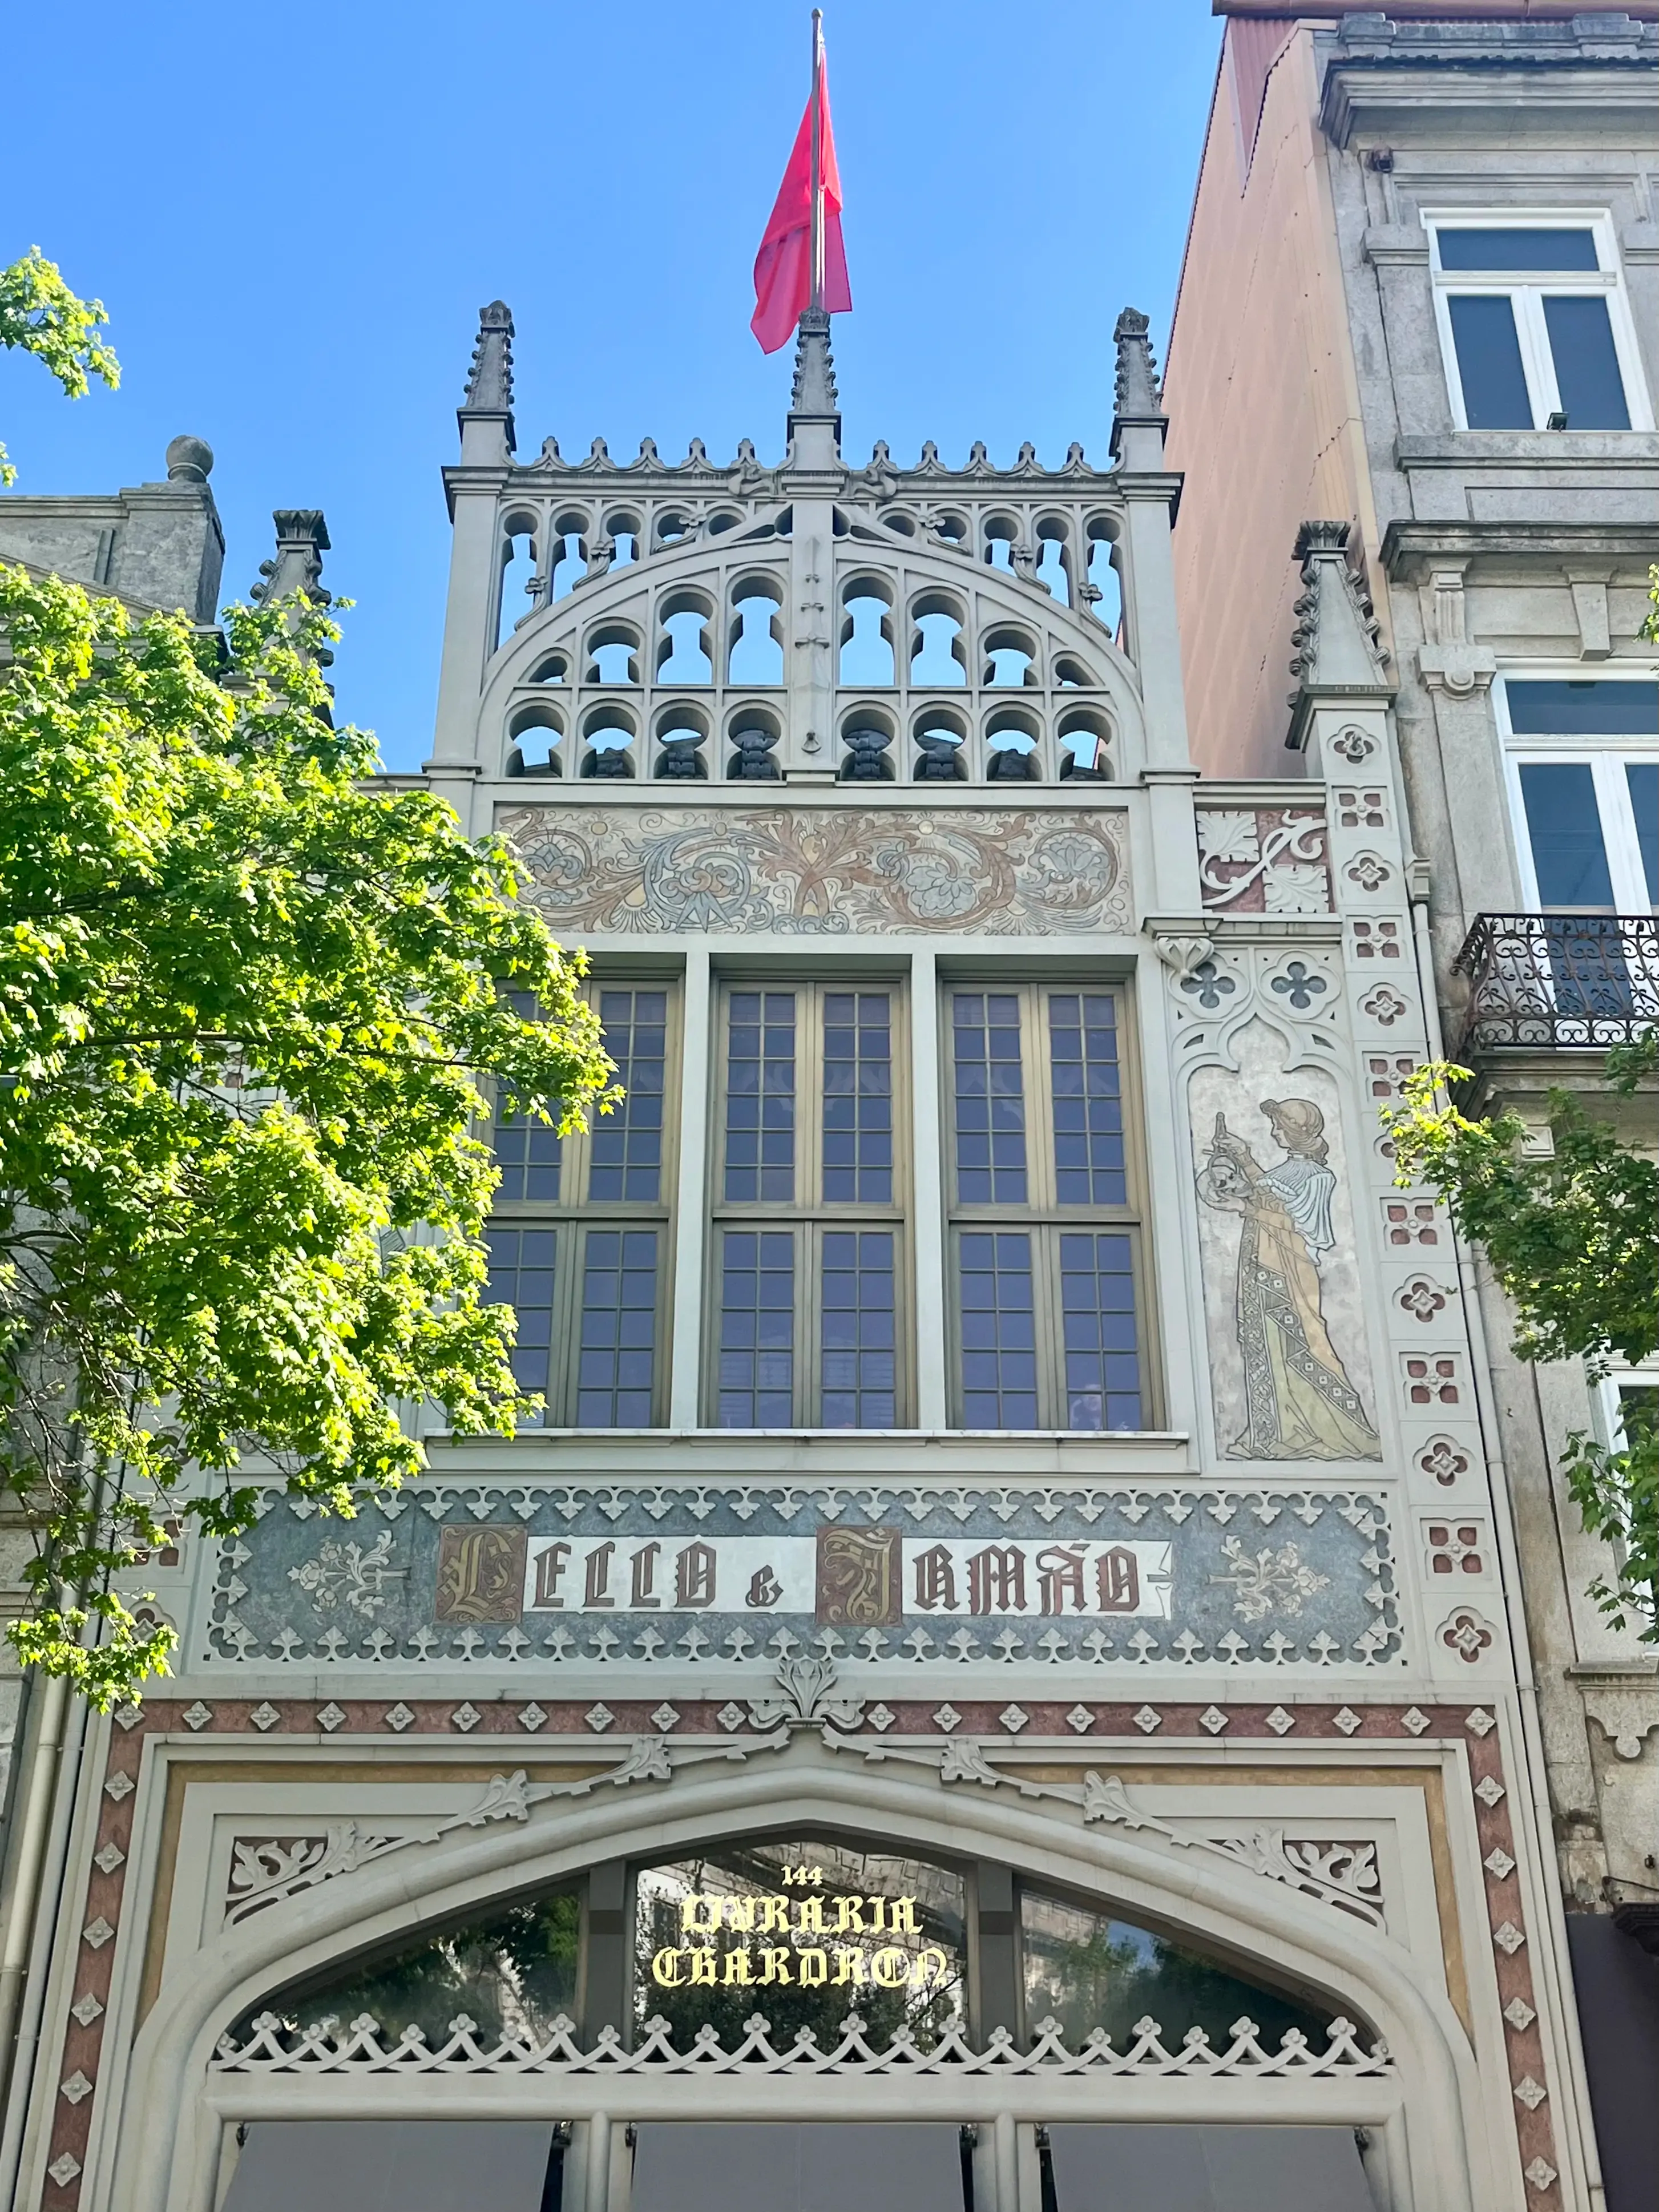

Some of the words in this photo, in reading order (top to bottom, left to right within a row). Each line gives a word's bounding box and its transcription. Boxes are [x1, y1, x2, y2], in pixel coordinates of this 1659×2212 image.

[438, 1529, 717, 1621] LELLO
[745, 1564, 784, 1608] &
[823, 1527, 1140, 1622] IRMÃO
[780, 1865, 824, 1886] 144
[680, 1895, 924, 1934] LIVRARIA
[652, 1945, 950, 1988] CHARDRON
